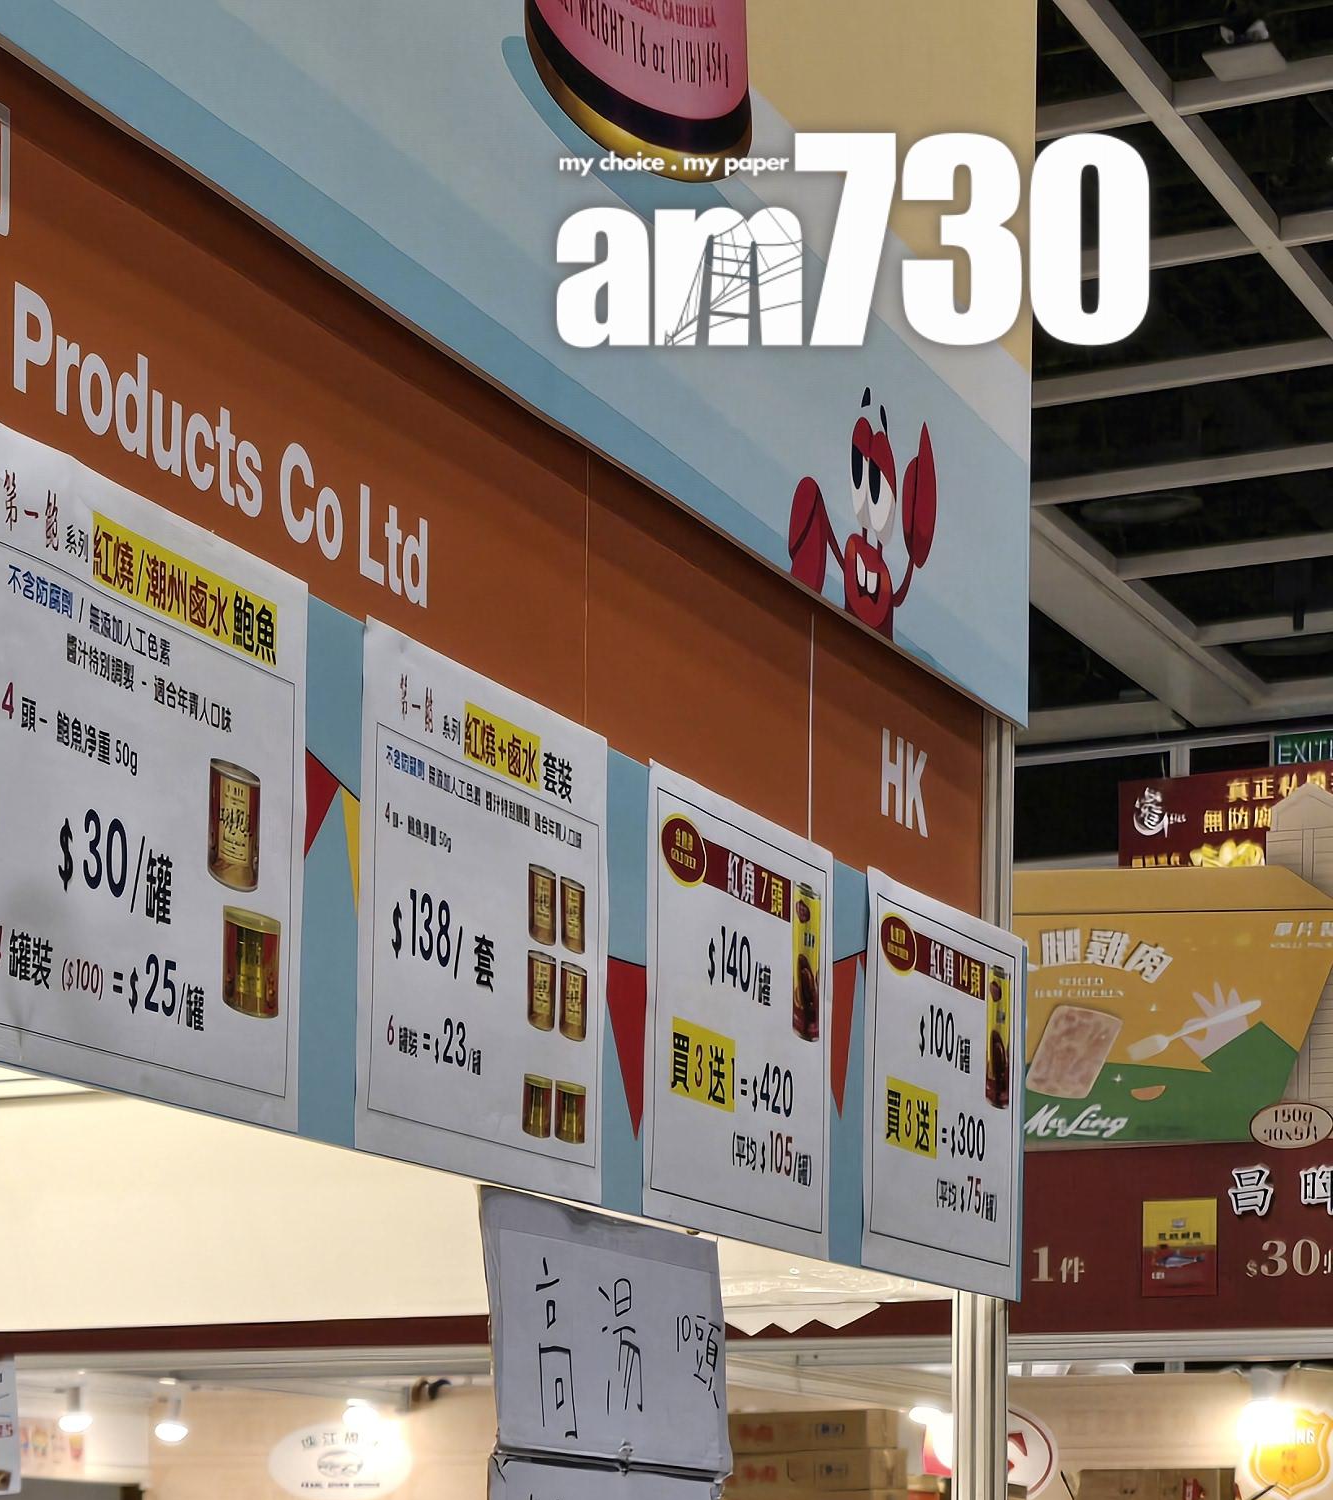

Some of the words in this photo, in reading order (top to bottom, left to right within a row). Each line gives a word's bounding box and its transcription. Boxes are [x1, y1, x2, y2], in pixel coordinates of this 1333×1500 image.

[12, 281, 263, 519] Products
[279, 441, 345, 561] Co
[358, 482, 430, 609] Ltd
[115, 739, 139, 776] 50g
[880, 727, 928, 839] HK
[1026, 926, 1173, 984] 腿雞肉
[1245, 1239, 1333, 1277] $30
[535, 1256, 644, 1441] 高湯
